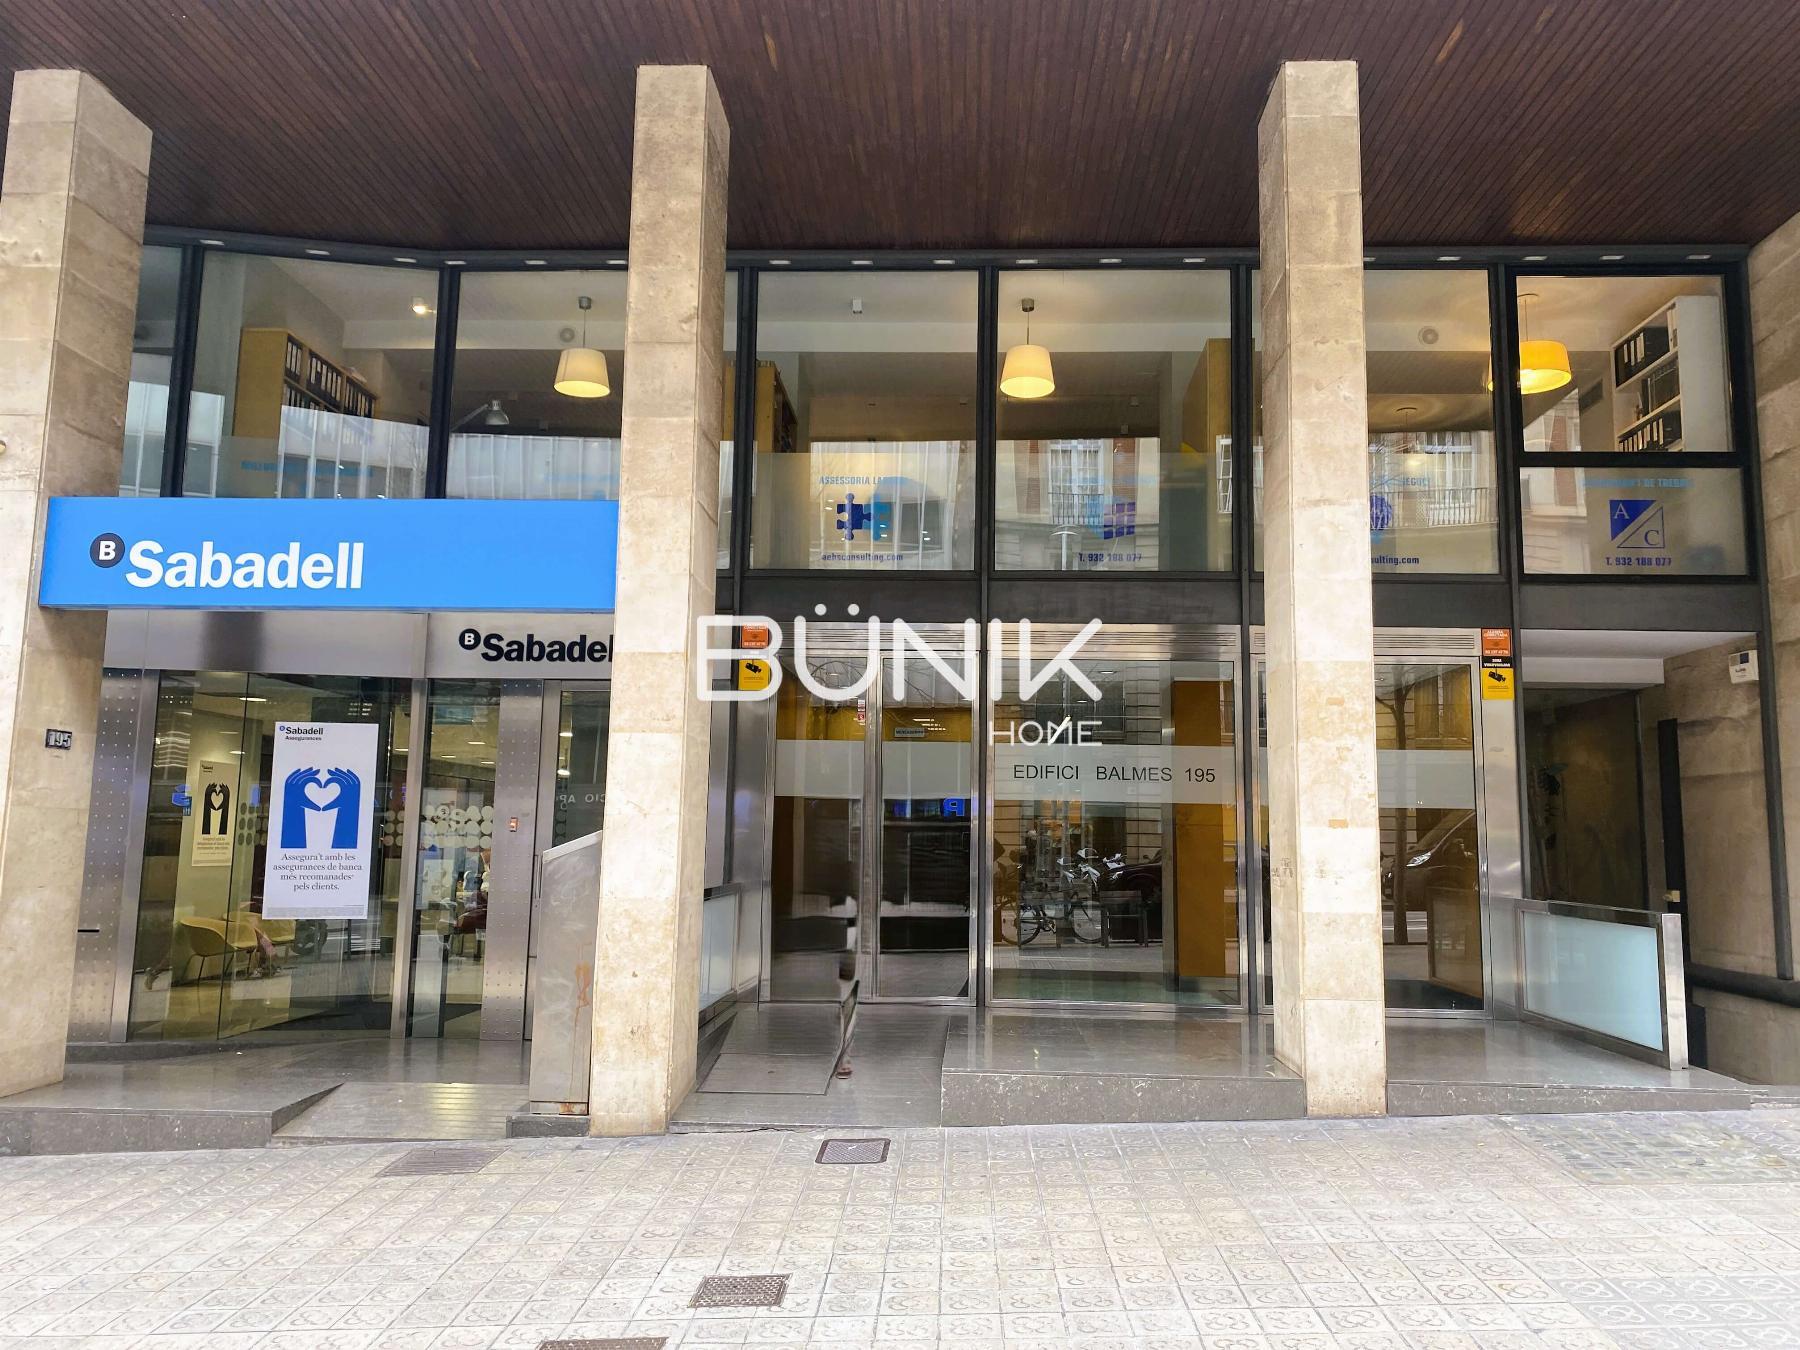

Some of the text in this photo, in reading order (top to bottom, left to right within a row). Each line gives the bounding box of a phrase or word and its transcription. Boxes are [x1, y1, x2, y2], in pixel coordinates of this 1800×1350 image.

[818, 475, 870, 485] ASSESSORIA
[1613, 503, 1630, 519] A
[1644, 529, 1660, 546] C
[1087, 552, 1105, 562] 932
[1605, 556, 1613, 566] T.
[1615, 556, 1633, 566] 932
[1655, 556, 1672, 566] 077
[125, 540, 364, 589] Sabadell
[481, 633, 614, 663] Sabadel
[285, 726, 324, 735] Sabadell
[48, 731, 71, 747] 195
[1013, 764, 1216, 783] EDIFICI BALMES 195
[281, 853, 356, 862] Assegura't amb les
[272, 863, 363, 872] assegurances de banca
[280, 873, 297, 881] més
[293, 882, 340, 892] pels clients.
